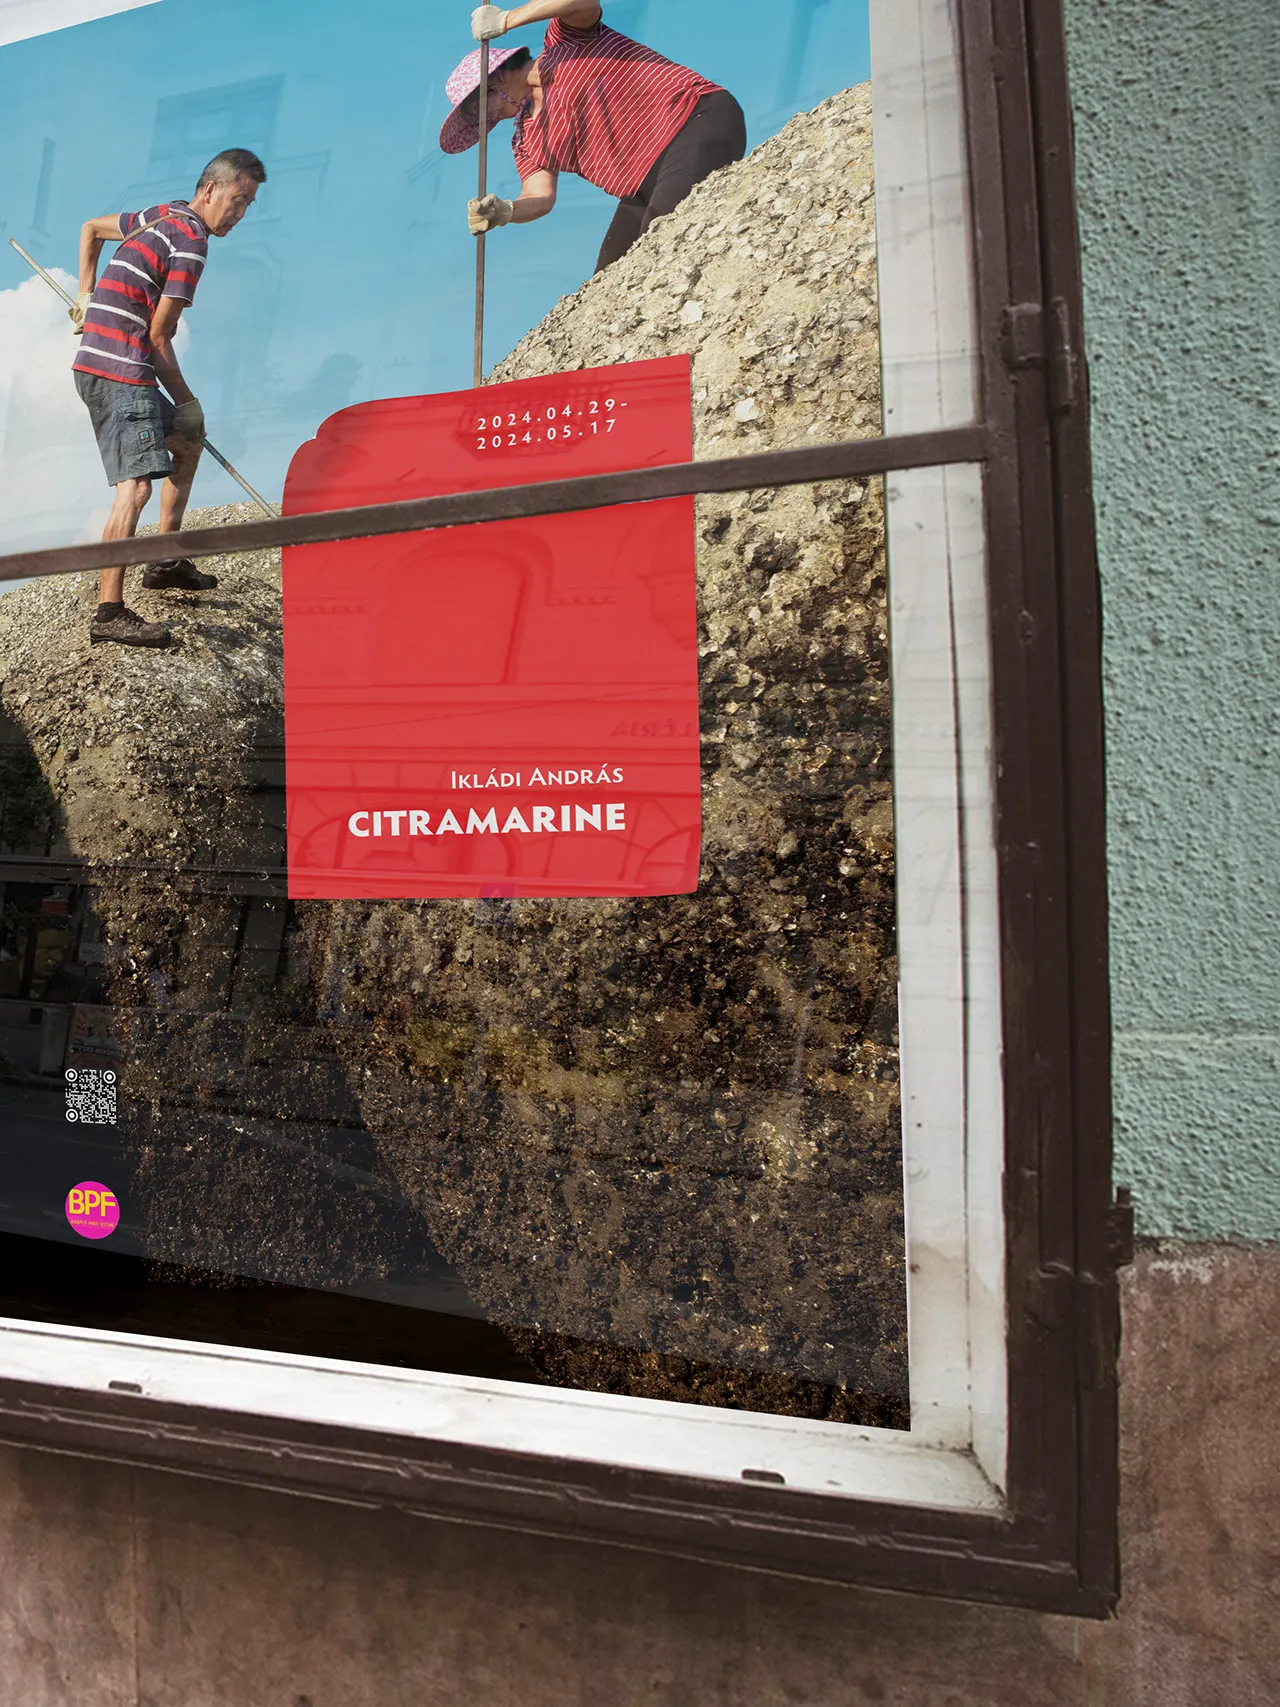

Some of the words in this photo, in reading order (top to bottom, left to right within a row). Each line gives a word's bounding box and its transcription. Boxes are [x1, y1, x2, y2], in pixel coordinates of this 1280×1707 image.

[477, 398, 628, 431] 2024.04.29-
[476, 418, 616, 450] 2024.05.17
[348, 803, 626, 838] CITRAMARINE
[69, 1188, 116, 1217] BPF
